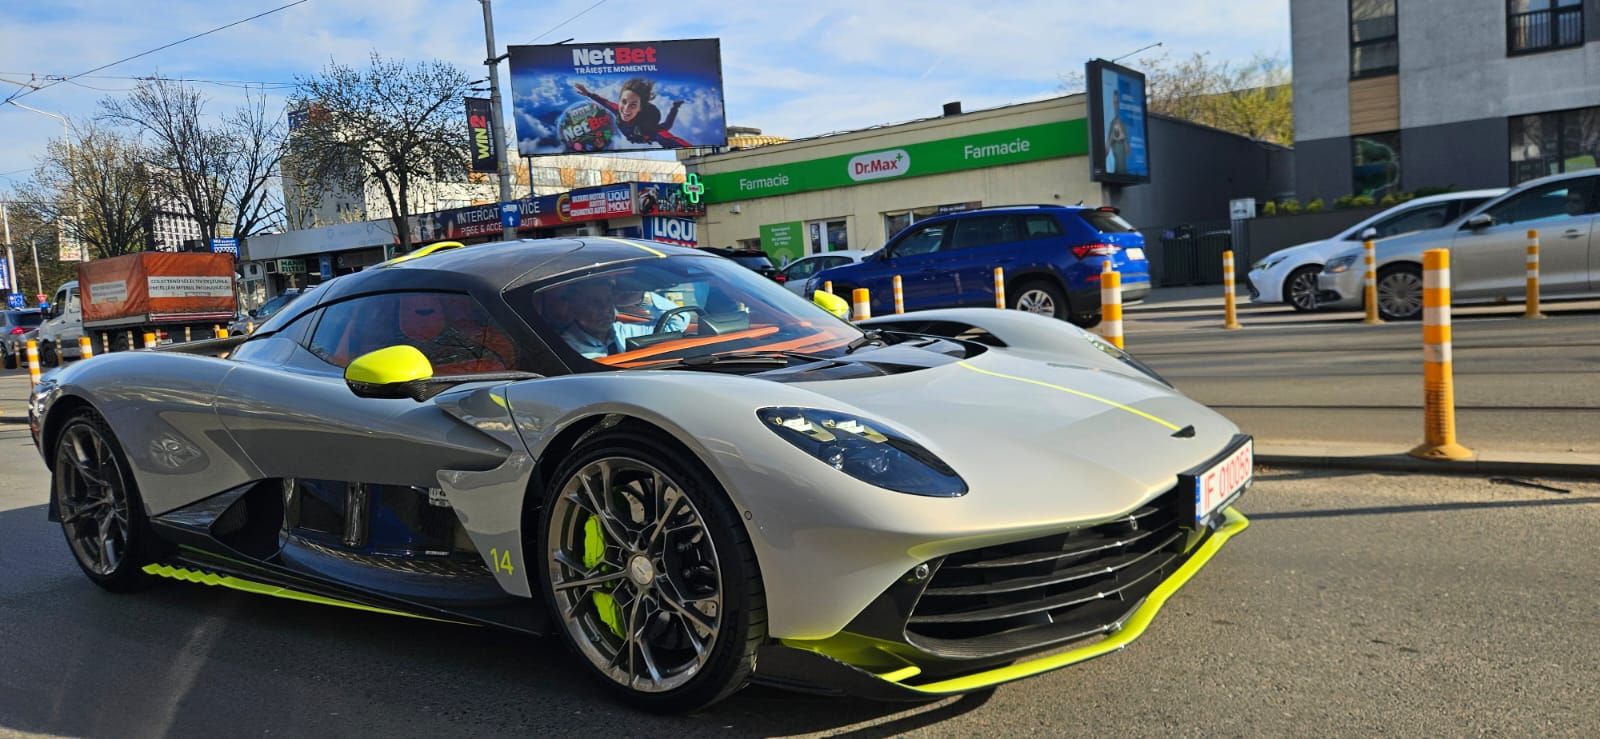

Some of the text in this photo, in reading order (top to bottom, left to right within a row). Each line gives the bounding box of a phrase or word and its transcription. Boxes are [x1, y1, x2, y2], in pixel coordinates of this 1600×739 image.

[572, 47, 656, 66] NetBet
[613, 64, 658, 73] MOMENTUL
[963, 138, 1030, 160] Farmacie
[739, 173, 789, 191] Farmacie
[607, 190, 630, 201] LIQUI
[456, 201, 541, 225] INTERCAT VICE
[607, 201, 631, 212] MOLY
[654, 217, 696, 242] LIQUI
[1204, 473, 1215, 511] IF
[490, 547, 514, 575] 14
